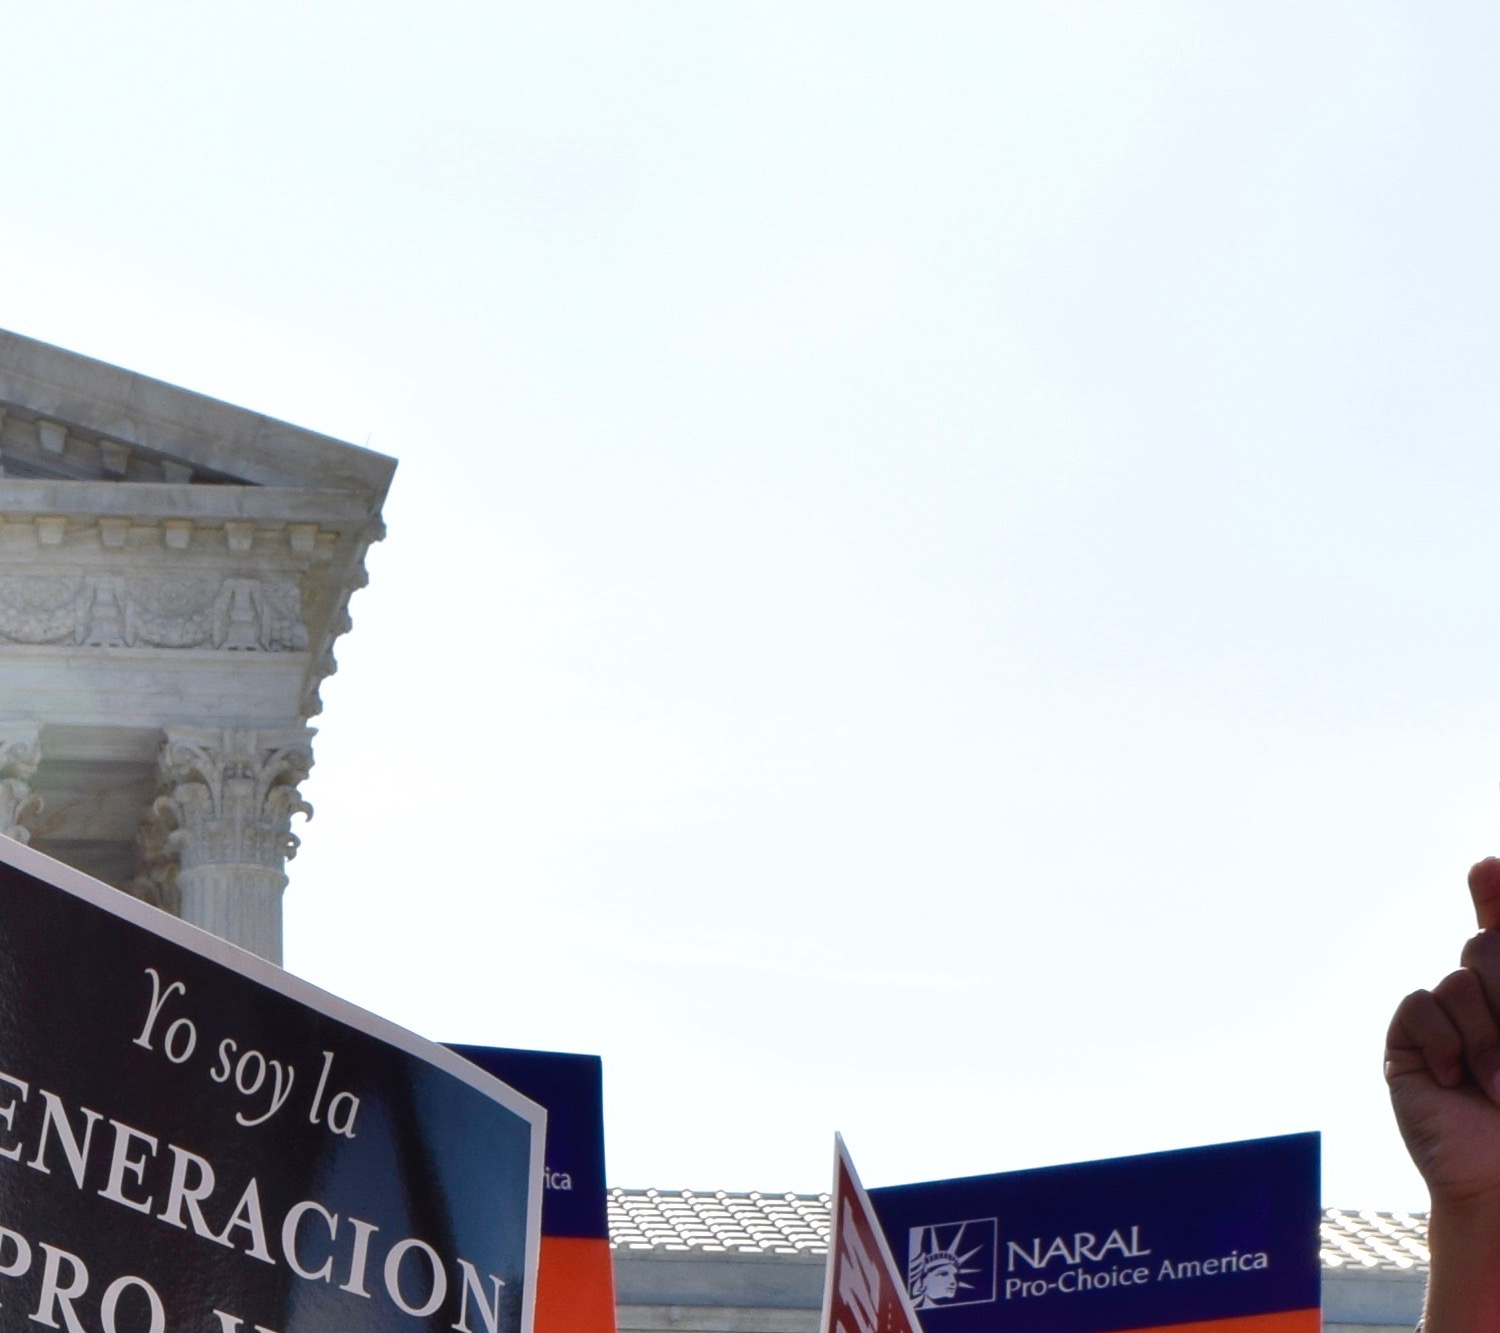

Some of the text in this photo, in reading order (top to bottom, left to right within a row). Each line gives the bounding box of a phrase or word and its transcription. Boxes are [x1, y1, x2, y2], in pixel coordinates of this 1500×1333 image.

[131, 966, 362, 1141] Yo soy la
[1005, 1225, 1151, 1272] NARAL
[1005, 1247, 1269, 1300] Pro-Choice America
